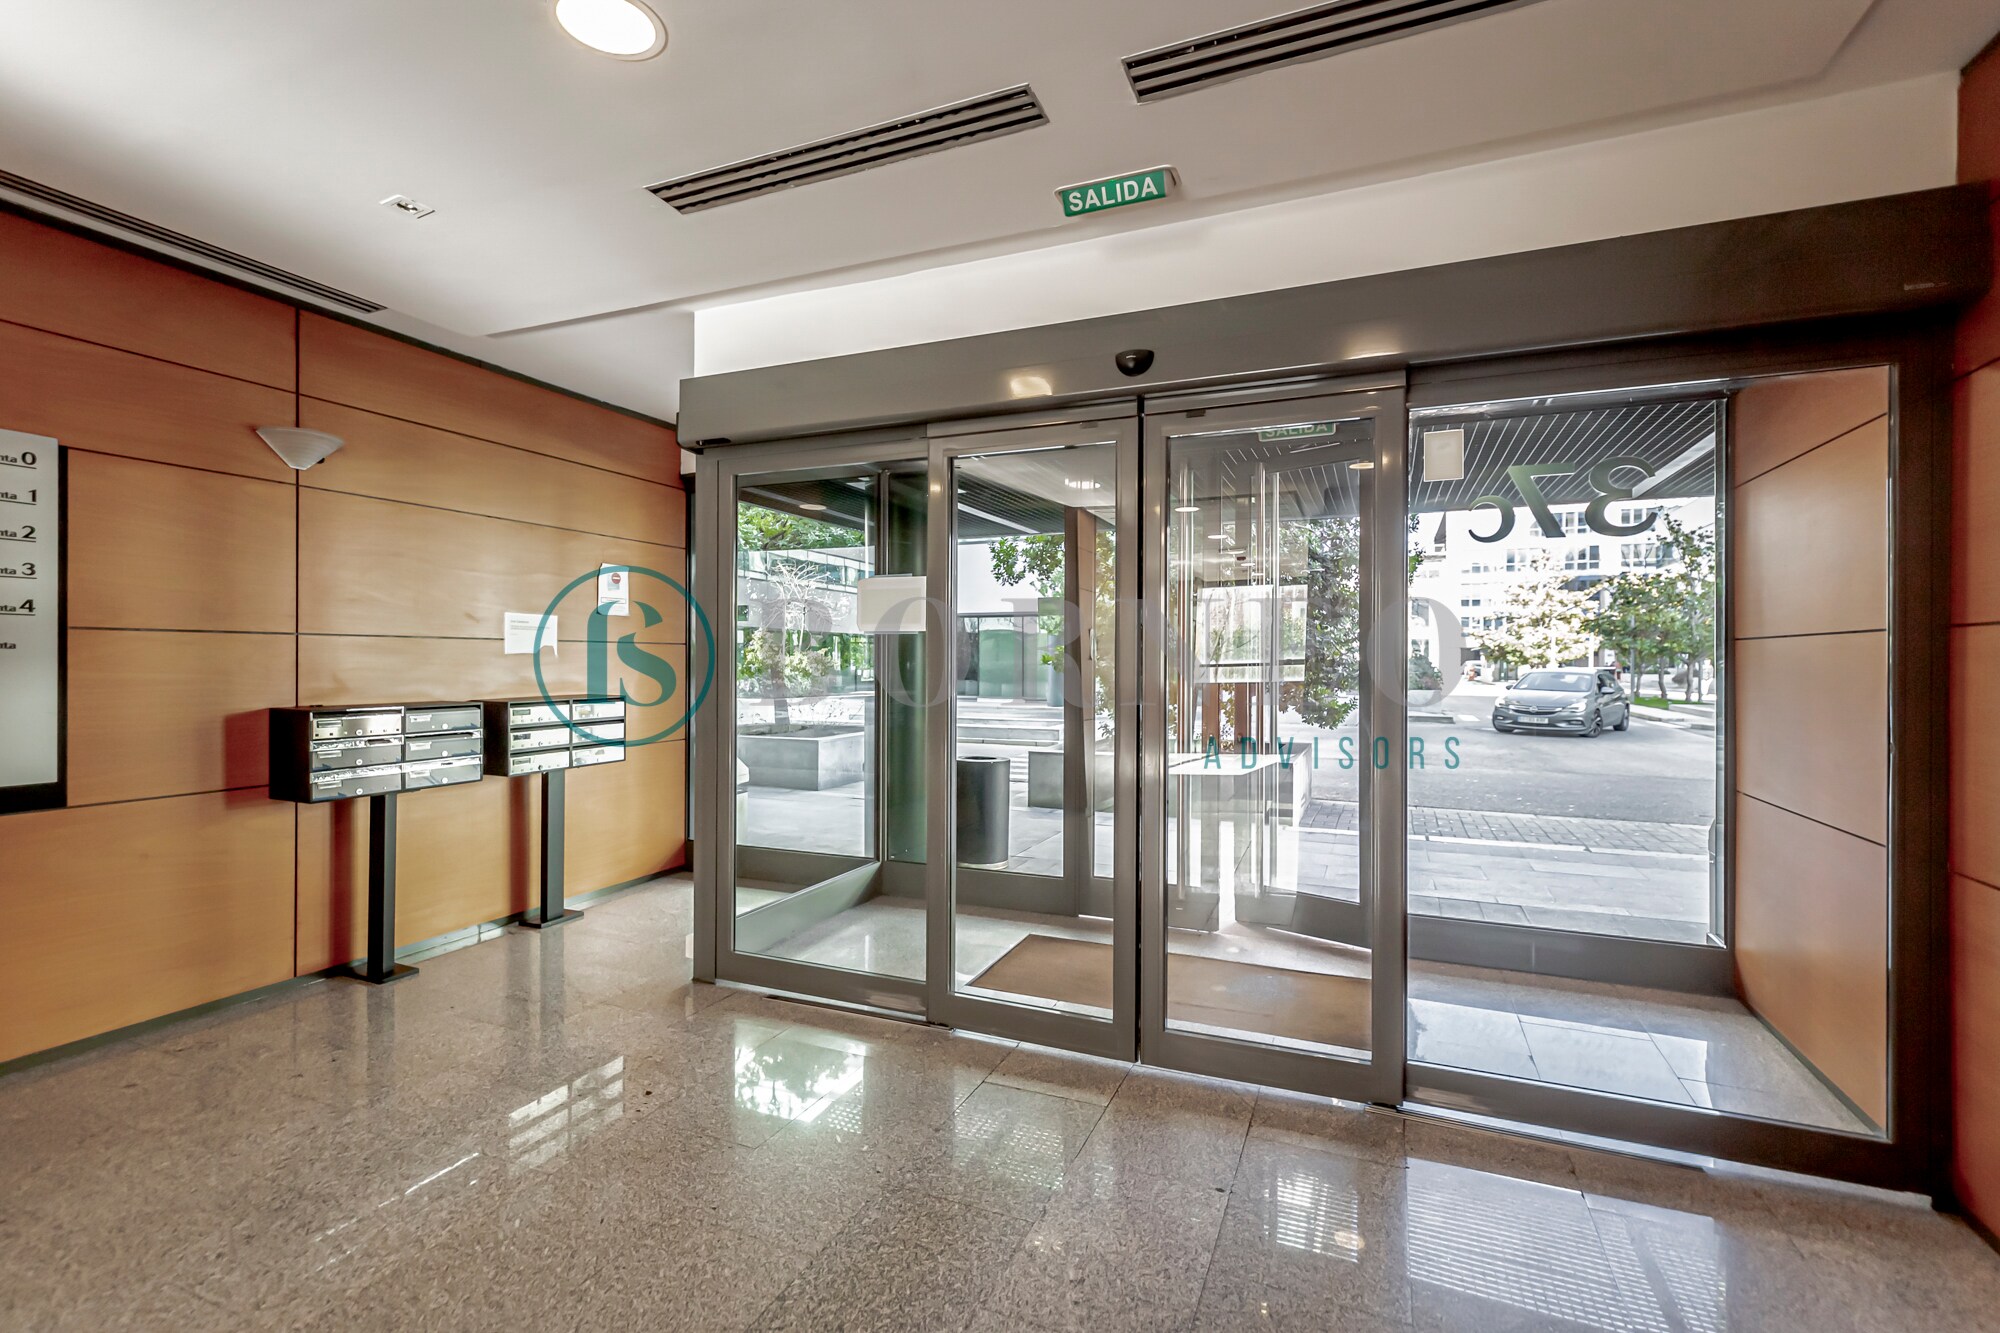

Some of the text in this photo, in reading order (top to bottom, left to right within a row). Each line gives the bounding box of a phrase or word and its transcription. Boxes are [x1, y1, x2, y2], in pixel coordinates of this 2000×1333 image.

[1068, 176, 1159, 212] SALIDA
[21, 451, 37, 466] 0
[28, 489, 37, 503] 1
[21, 525, 37, 540] 2
[21, 562, 37, 576] 3
[19, 599, 36, 613] 4
